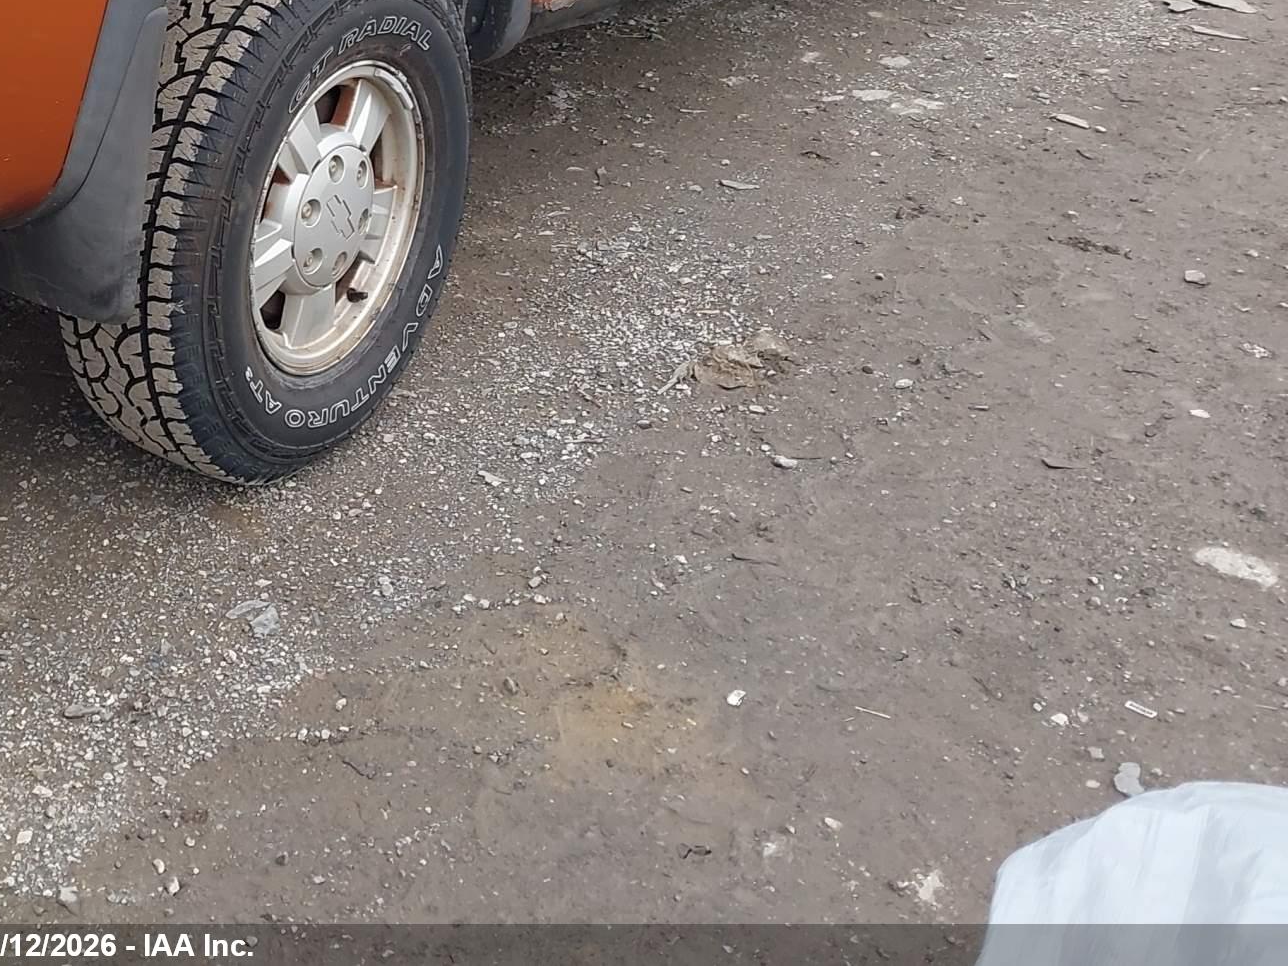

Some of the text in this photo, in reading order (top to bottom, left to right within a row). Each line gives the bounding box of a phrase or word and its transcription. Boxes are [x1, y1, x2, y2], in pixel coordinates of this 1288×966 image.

[288, 15, 432, 113] GT RADIAL
[284, 244, 444, 428] ADVENTURO
